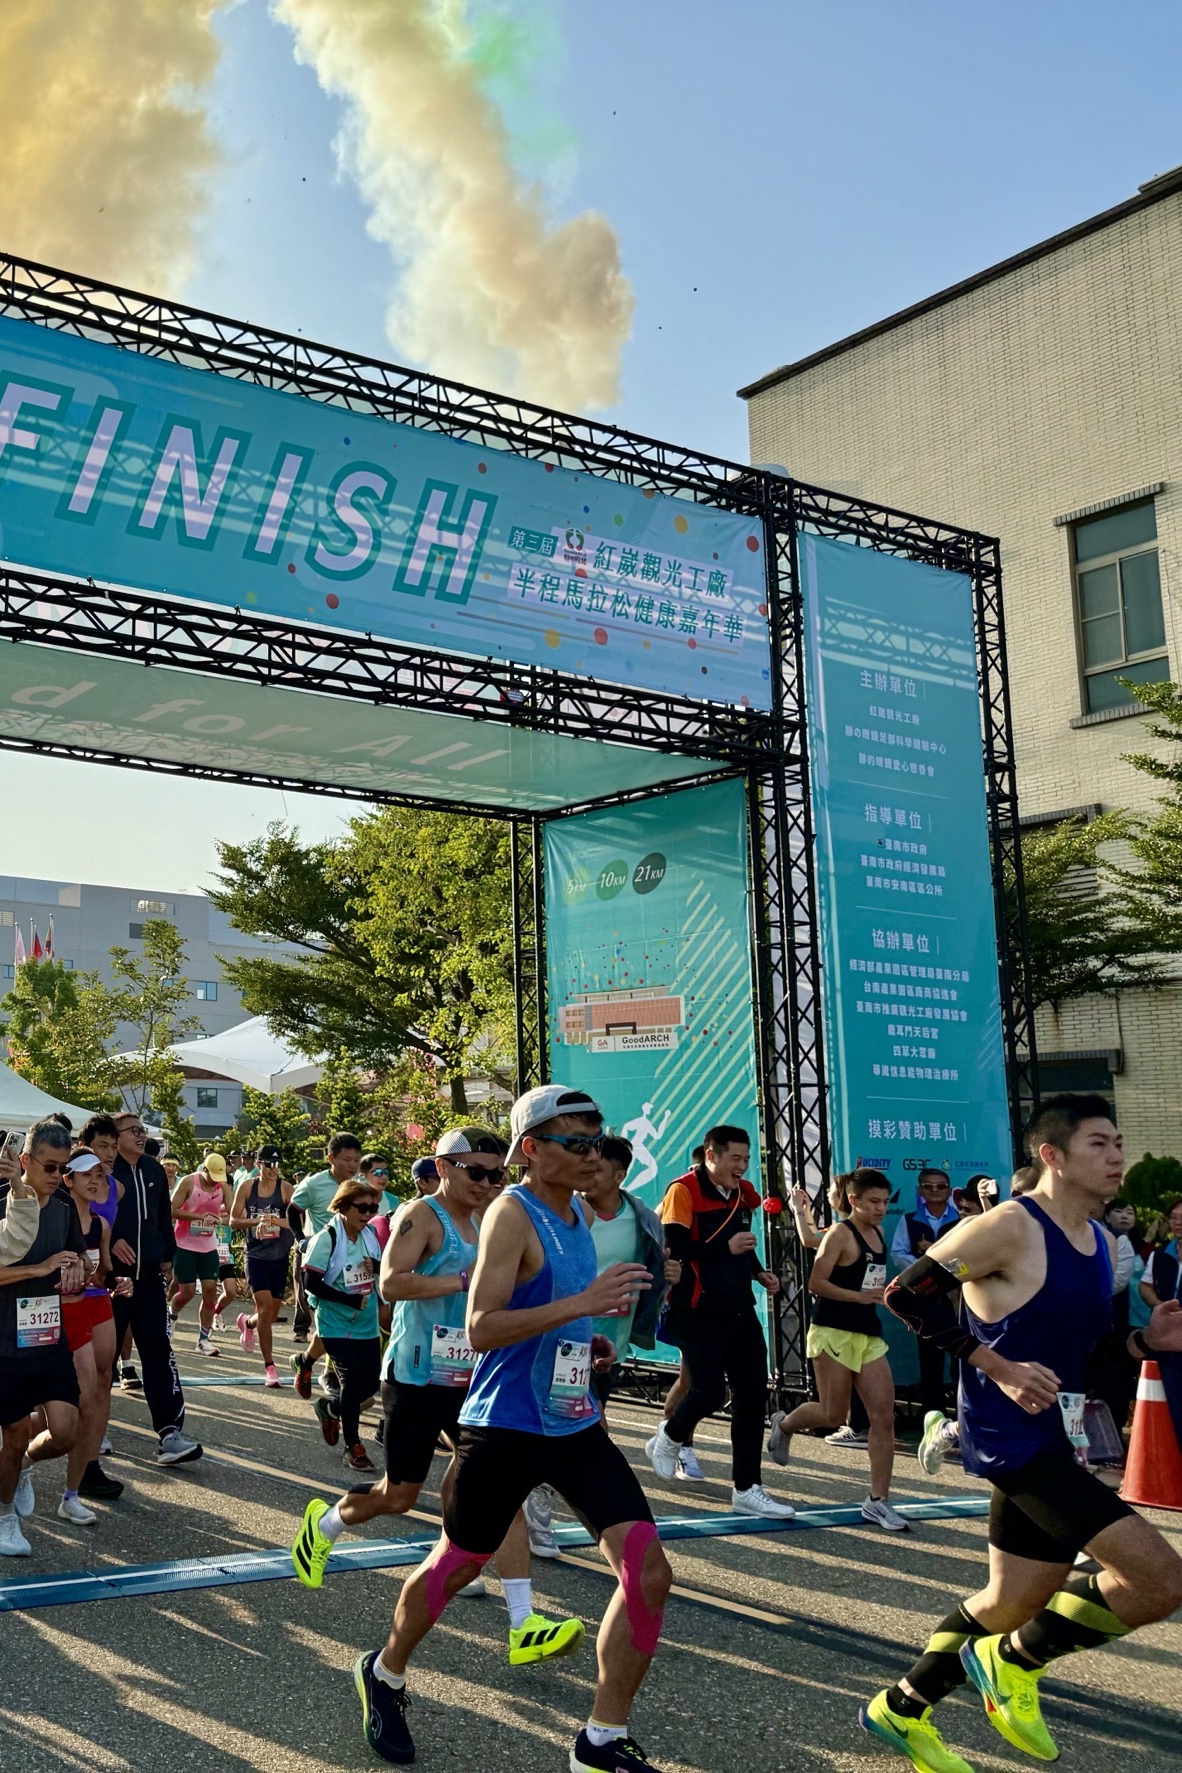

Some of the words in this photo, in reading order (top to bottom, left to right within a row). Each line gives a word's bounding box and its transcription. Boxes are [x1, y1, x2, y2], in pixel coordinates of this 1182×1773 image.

[510, 529, 555, 557] 第三屆
[514, 567, 744, 643] 半程馬拉松健康嘉年華
[860, 669, 917, 698] 主辦單位
[136, 698, 308, 742] for
[334, 734, 510, 769] All
[864, 802, 922, 830] 指導單位
[599, 871, 626, 889] 10KM
[634, 864, 664, 883] 21KM
[872, 928, 930, 953] 協辦單位
[621, 1034, 670, 1045] GoodARCH
[30, 1311, 59, 1325] 31272
